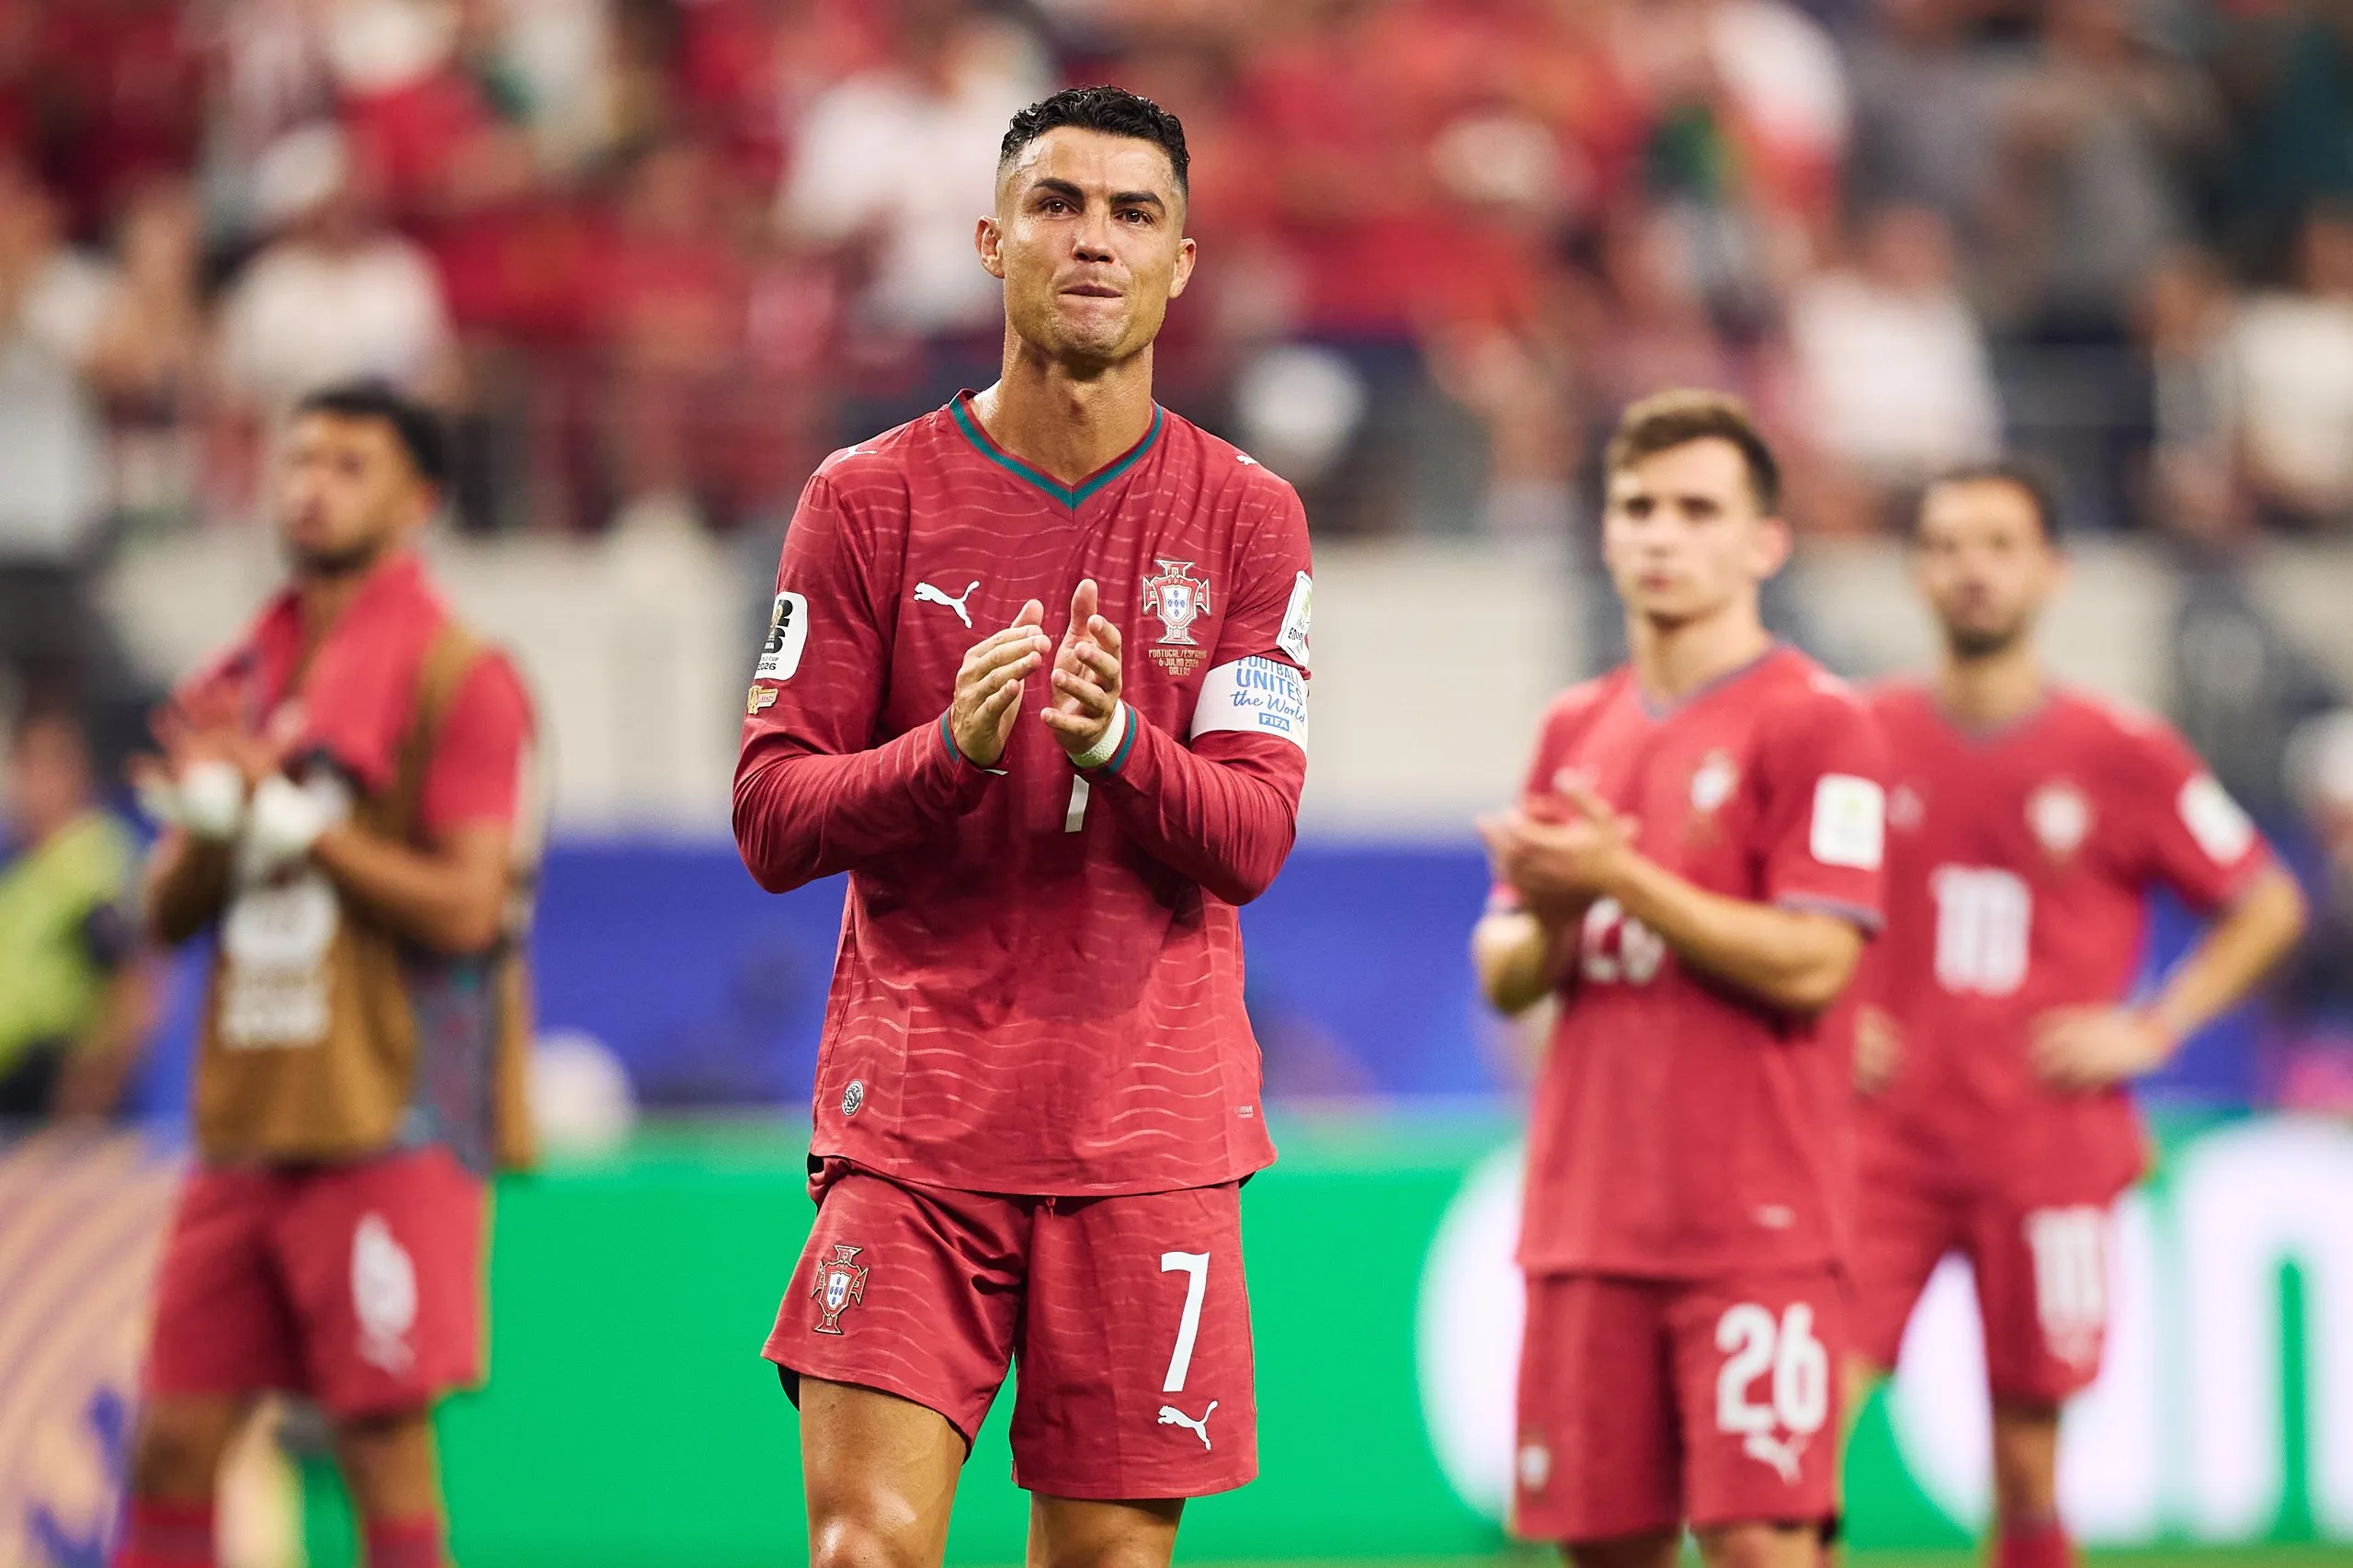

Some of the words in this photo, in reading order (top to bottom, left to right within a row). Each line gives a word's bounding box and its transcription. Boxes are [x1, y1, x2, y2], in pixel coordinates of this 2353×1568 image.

[1158, 658, 1164, 666] 6
[1185, 658, 1199, 668] 2026
[1168, 666, 1191, 676] DALLAS
[1236, 668, 1303, 706] UNITES
[1230, 690, 1263, 707] the
[1267, 694, 1306, 724] World
[1263, 715, 1289, 731] FIFA
[1161, 1251, 1211, 1392] 7
[1715, 1302, 1828, 1434] 26
